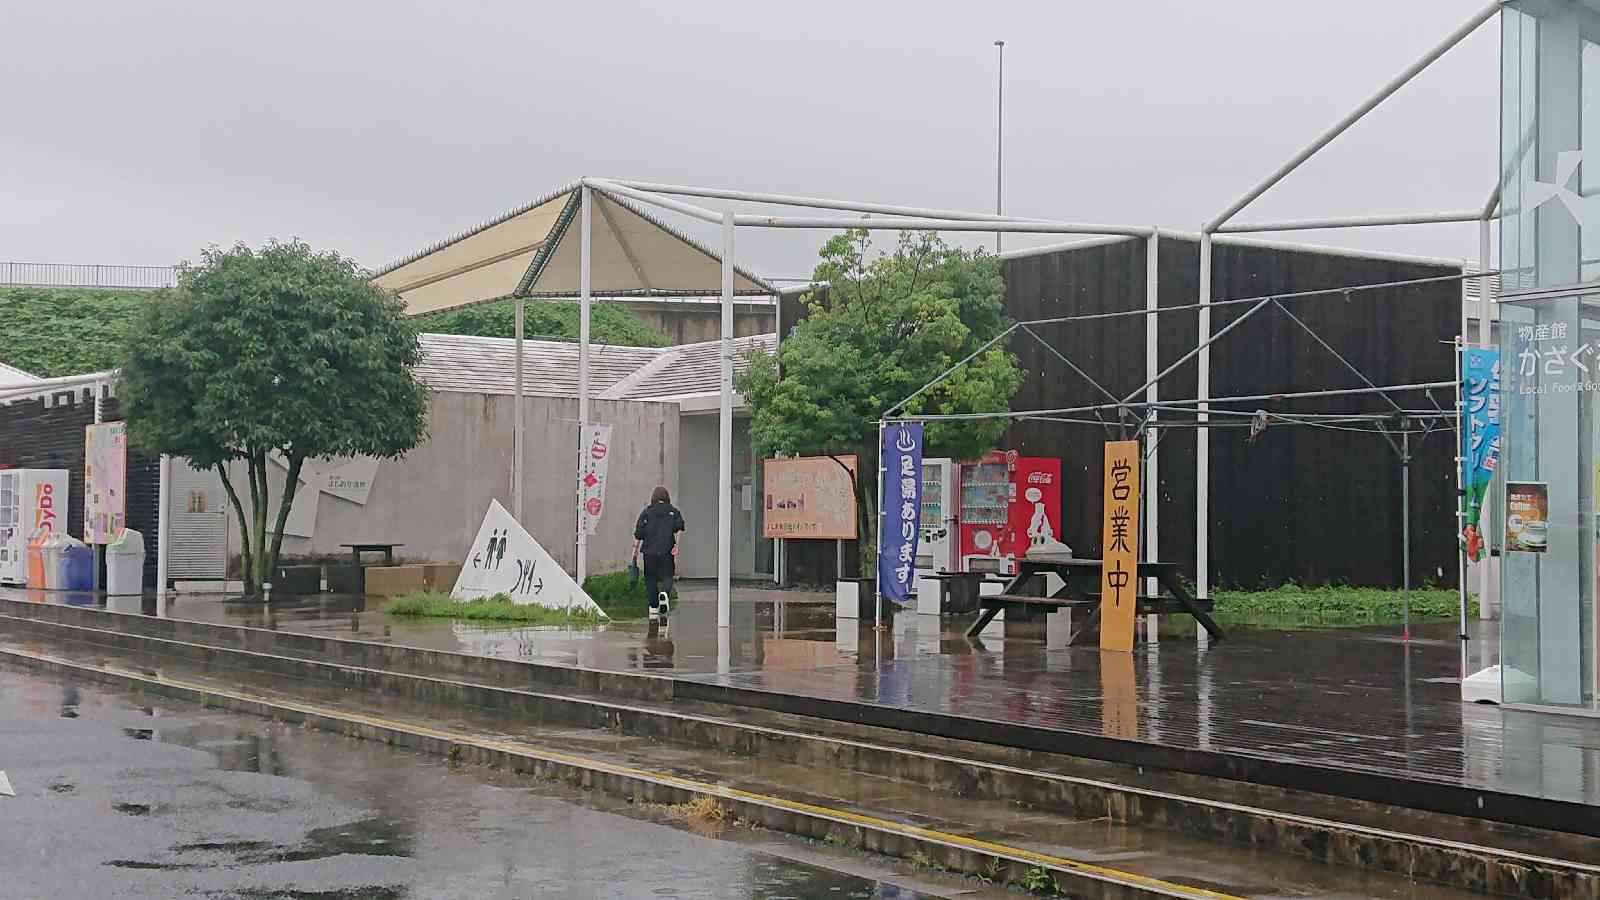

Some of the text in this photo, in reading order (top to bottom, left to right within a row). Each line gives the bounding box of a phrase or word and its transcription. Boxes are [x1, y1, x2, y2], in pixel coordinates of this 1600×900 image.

[1518, 321, 1568, 342] 物産館
[1518, 342, 1600, 377] かざぐ
[1519, 383, 1547, 395] Local
[894, 454, 916, 584] 足湯あります
[1107, 457, 1132, 608] 営業中
